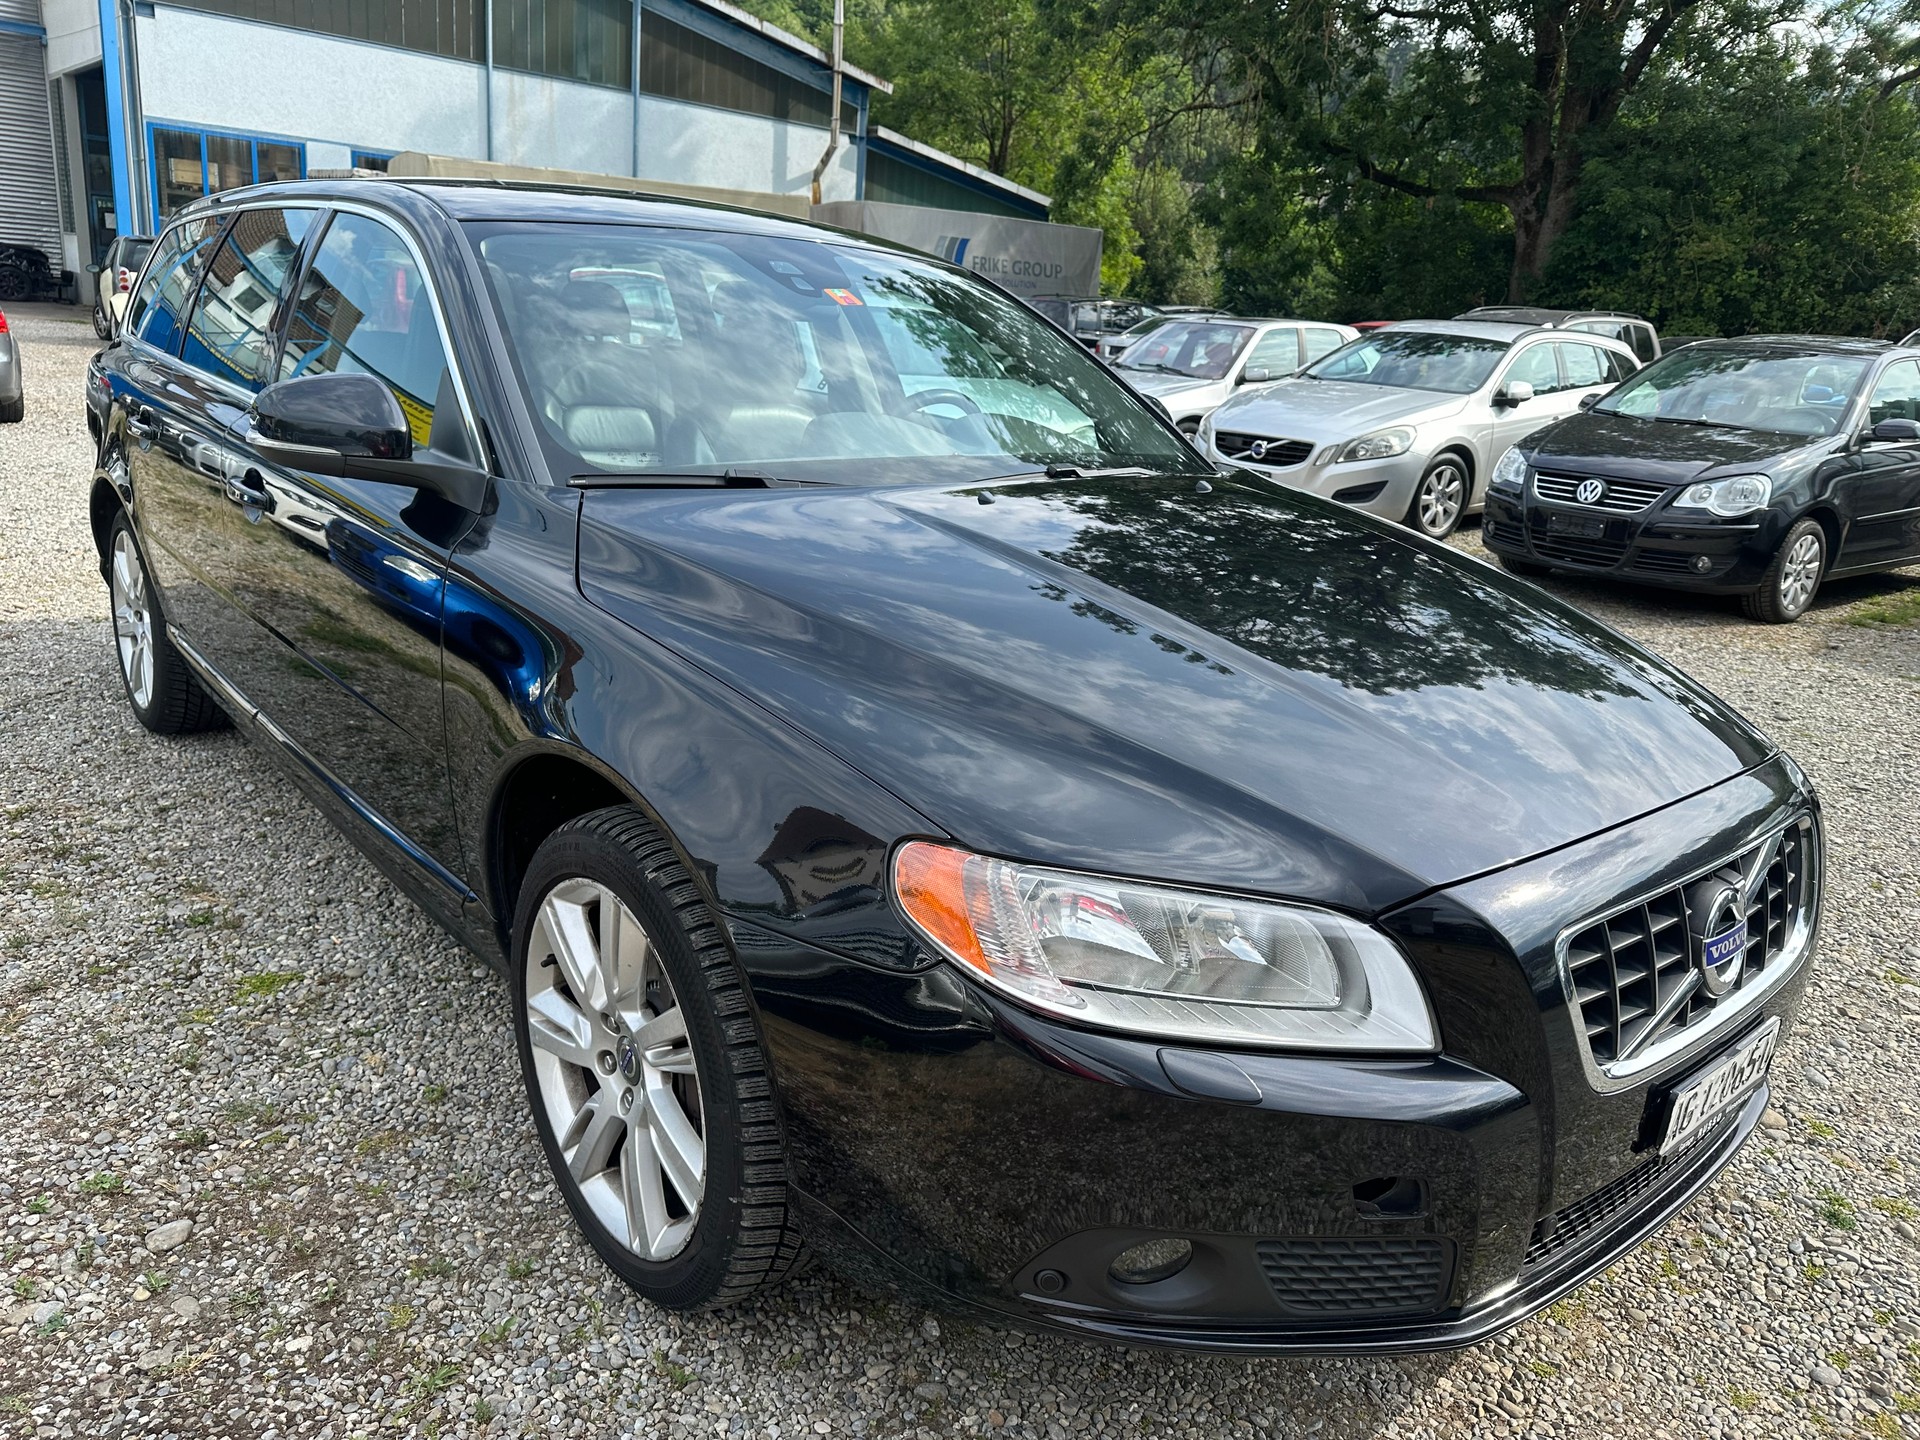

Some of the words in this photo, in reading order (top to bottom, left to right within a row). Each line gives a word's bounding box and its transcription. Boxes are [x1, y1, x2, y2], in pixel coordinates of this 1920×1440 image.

[972, 255, 1008, 274] FRIKE
[1012, 260, 1063, 279] GROUP
[1577, 480, 1602, 503] VW
[1709, 928, 1747, 959] VOLVO
